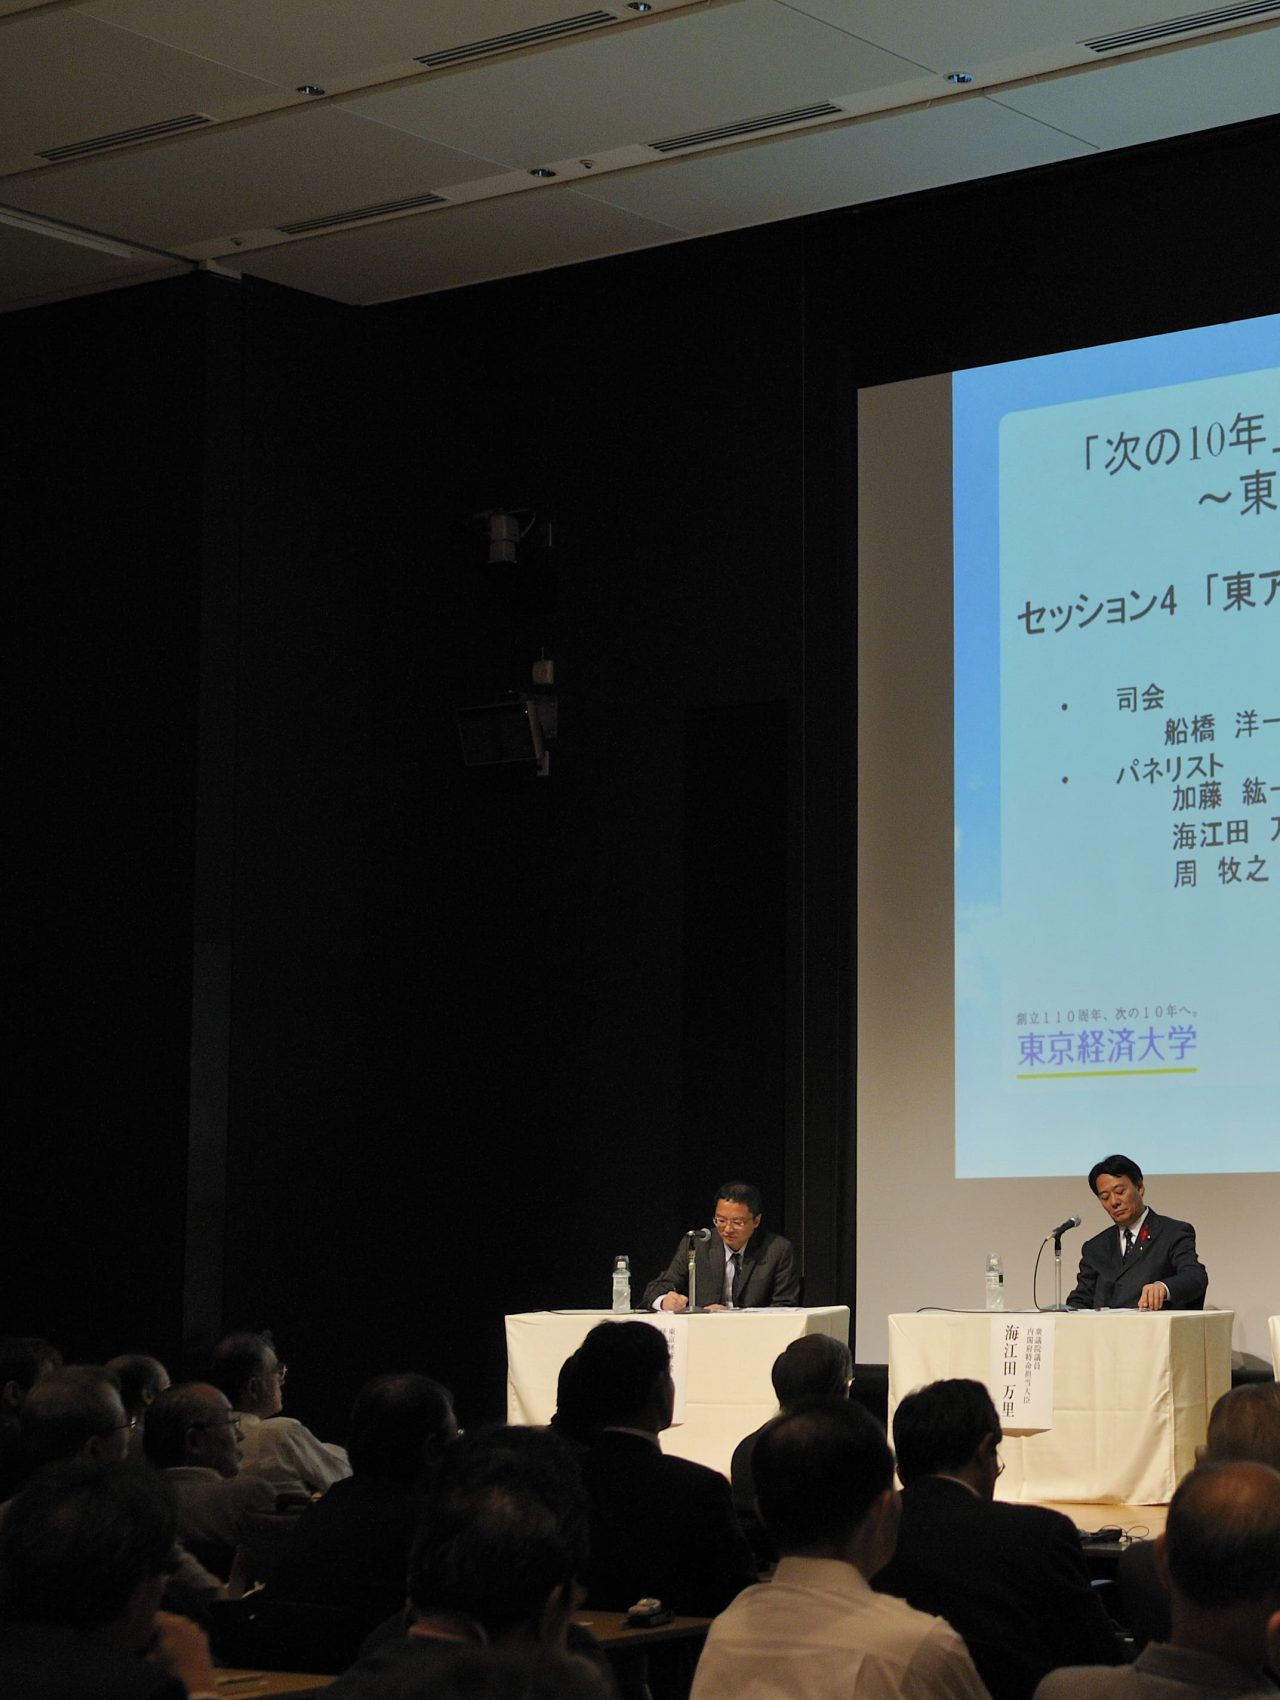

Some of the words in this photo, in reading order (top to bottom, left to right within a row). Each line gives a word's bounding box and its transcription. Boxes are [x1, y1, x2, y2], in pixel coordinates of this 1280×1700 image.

[1017, 584, 1178, 635] セッション4
[1116, 683, 1165, 712] 司会
[1164, 714, 1216, 746] 船橋
[1116, 753, 1224, 784] パネリスト
[1172, 781, 1223, 811] 加藤
[1172, 820, 1249, 851] 海江田
[1174, 860, 1197, 888] 周
[1218, 854, 1270, 885] 牧之
[1017, 1025, 1198, 1067] 東京経済大学
[1004, 1324, 1020, 1377] 海江田
[1002, 1384, 1017, 1418] 万里
